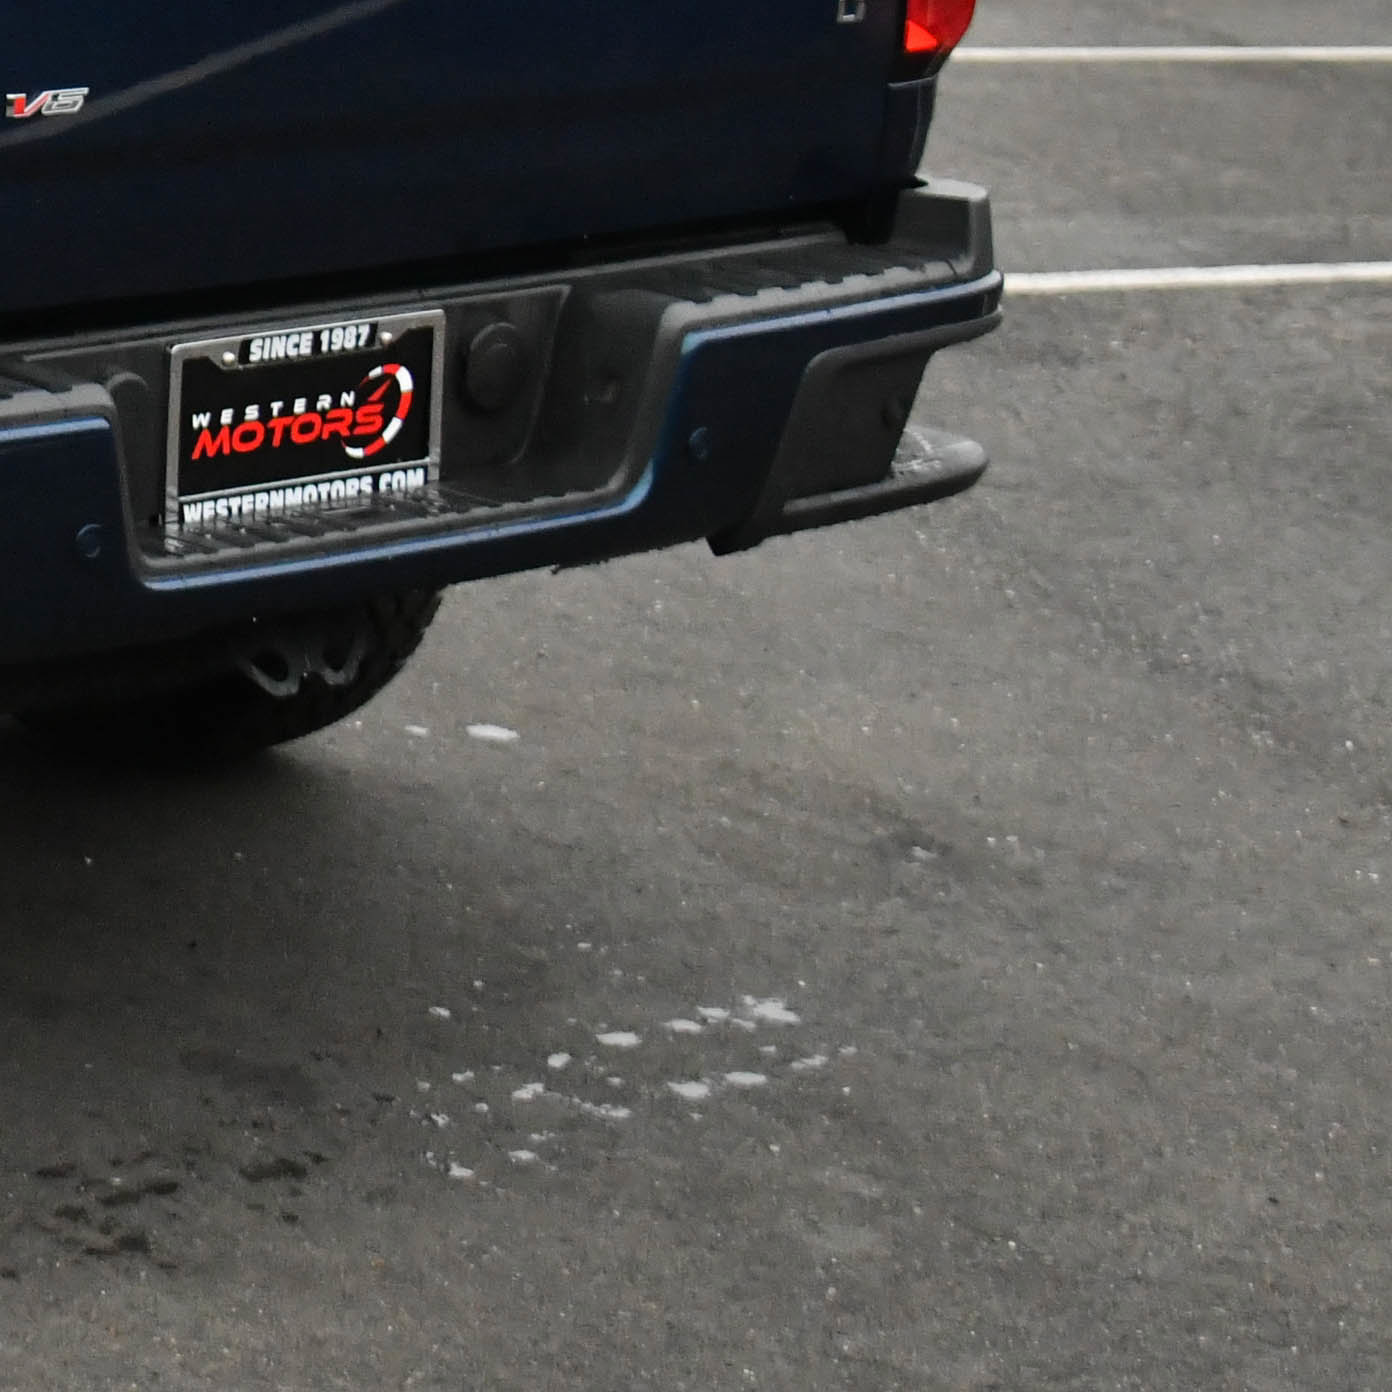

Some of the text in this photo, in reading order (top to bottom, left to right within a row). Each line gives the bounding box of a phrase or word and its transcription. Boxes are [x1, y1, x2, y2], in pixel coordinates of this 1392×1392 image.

[6, 87, 89, 118] V6
[249, 325, 370, 362] SINCE 1987
[192, 391, 355, 429] WESTERN
[191, 402, 384, 460] MOTORS
[182, 467, 425, 523] WESTERNMOTORSCOM
